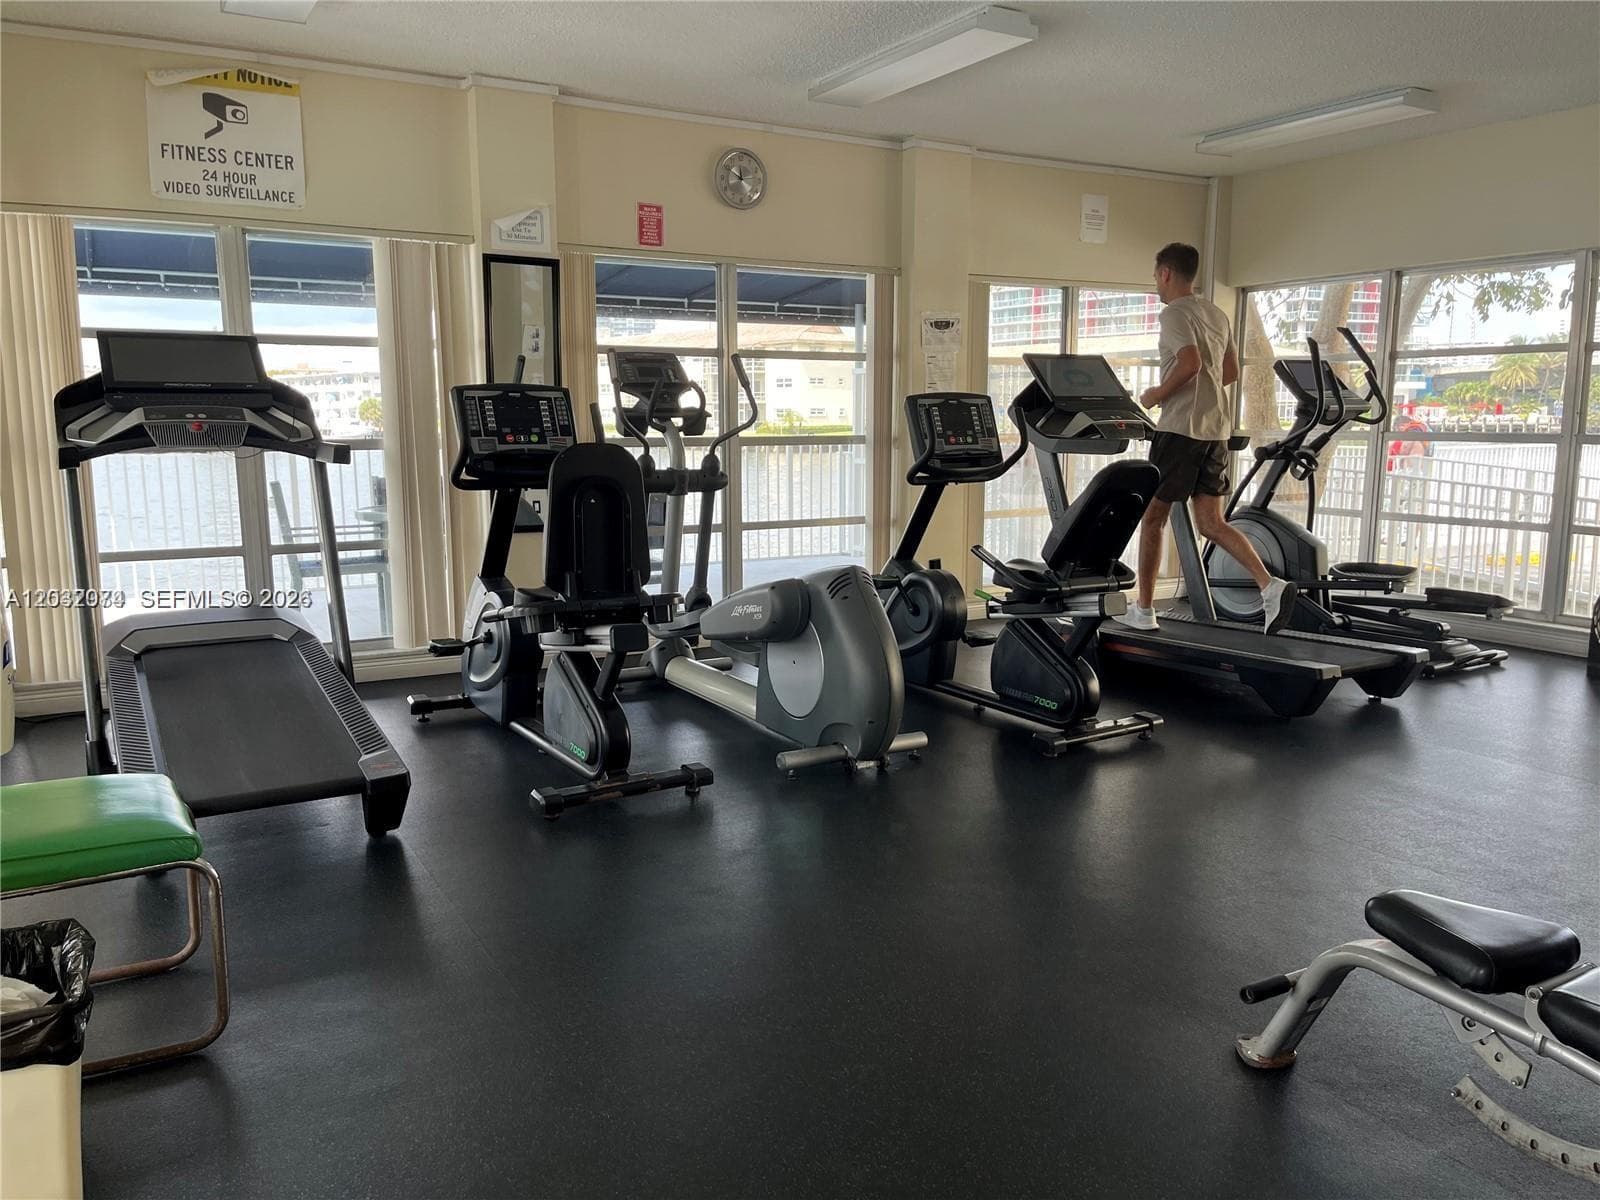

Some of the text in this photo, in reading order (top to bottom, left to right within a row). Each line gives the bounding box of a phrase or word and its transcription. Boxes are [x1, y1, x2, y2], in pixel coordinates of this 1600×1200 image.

[160, 143, 294, 171] FITNESS CENTER
[202, 169, 257, 186] 24 HOUR
[163, 181, 295, 203] VIDEO SURVEILLANCE
[1033, 695, 1058, 710] 7000
[569, 742, 586, 760] 7000
